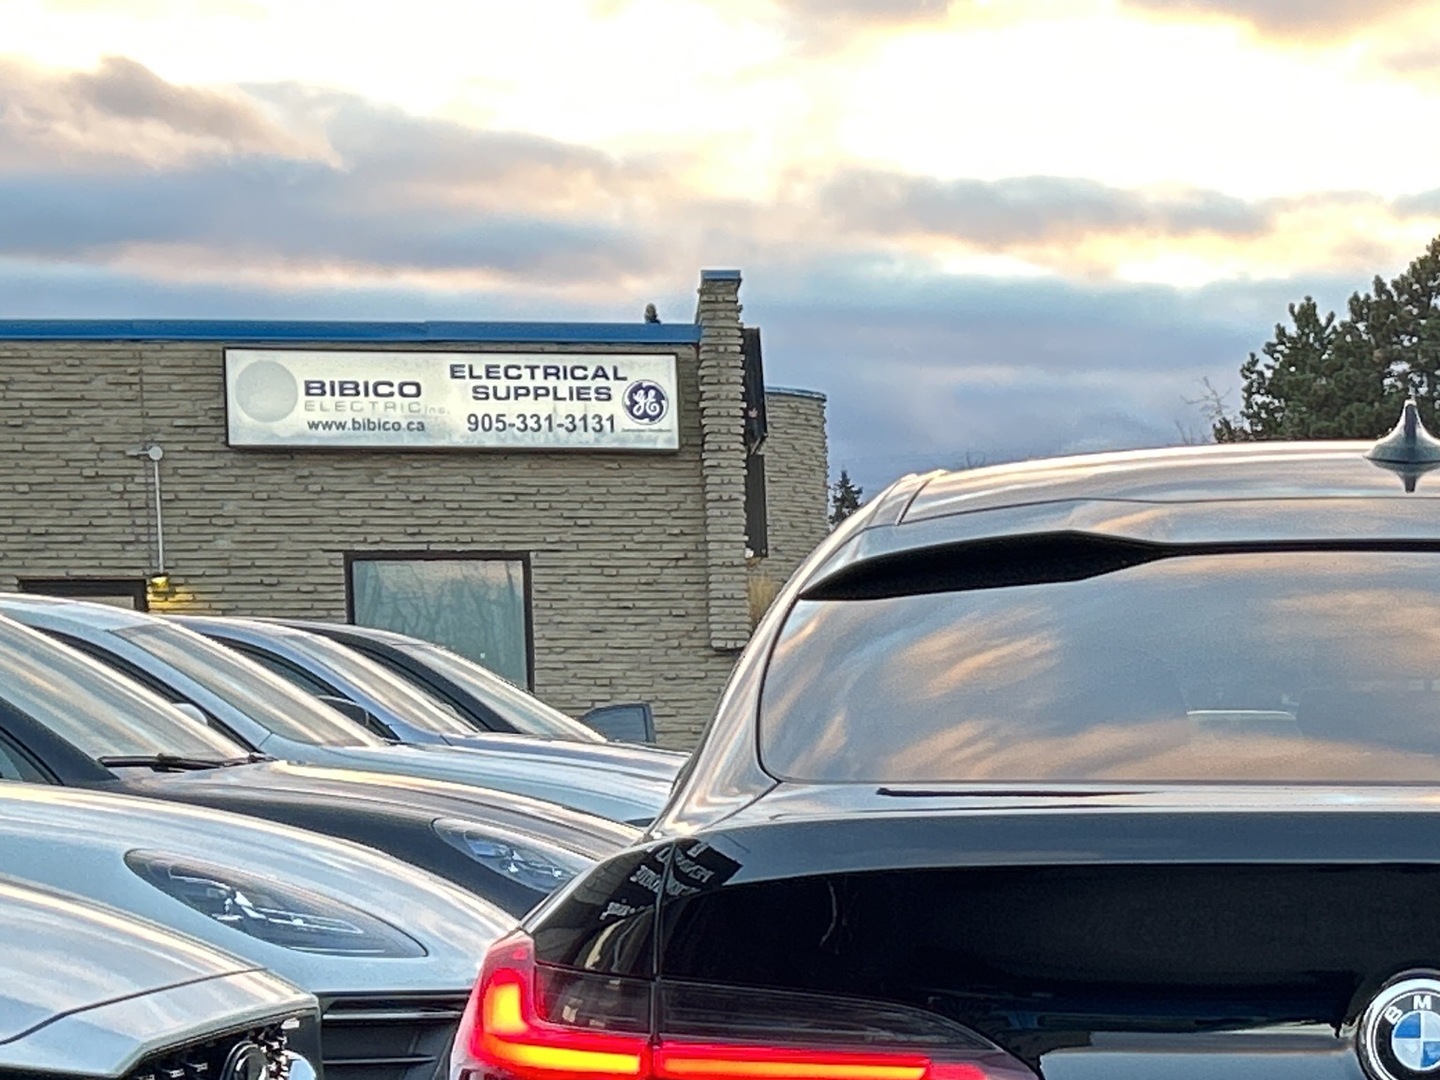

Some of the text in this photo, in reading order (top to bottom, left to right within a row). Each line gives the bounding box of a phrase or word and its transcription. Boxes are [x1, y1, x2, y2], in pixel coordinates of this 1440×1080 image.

[450, 364, 628, 381] ELECTRICAL
[304, 380, 422, 398] BIBICO
[472, 385, 612, 401] SUPPLIES
[304, 401, 421, 413] ELECTRIC
[307, 418, 425, 432] www.bibico.ca
[467, 413, 615, 433] 905-331-3131
